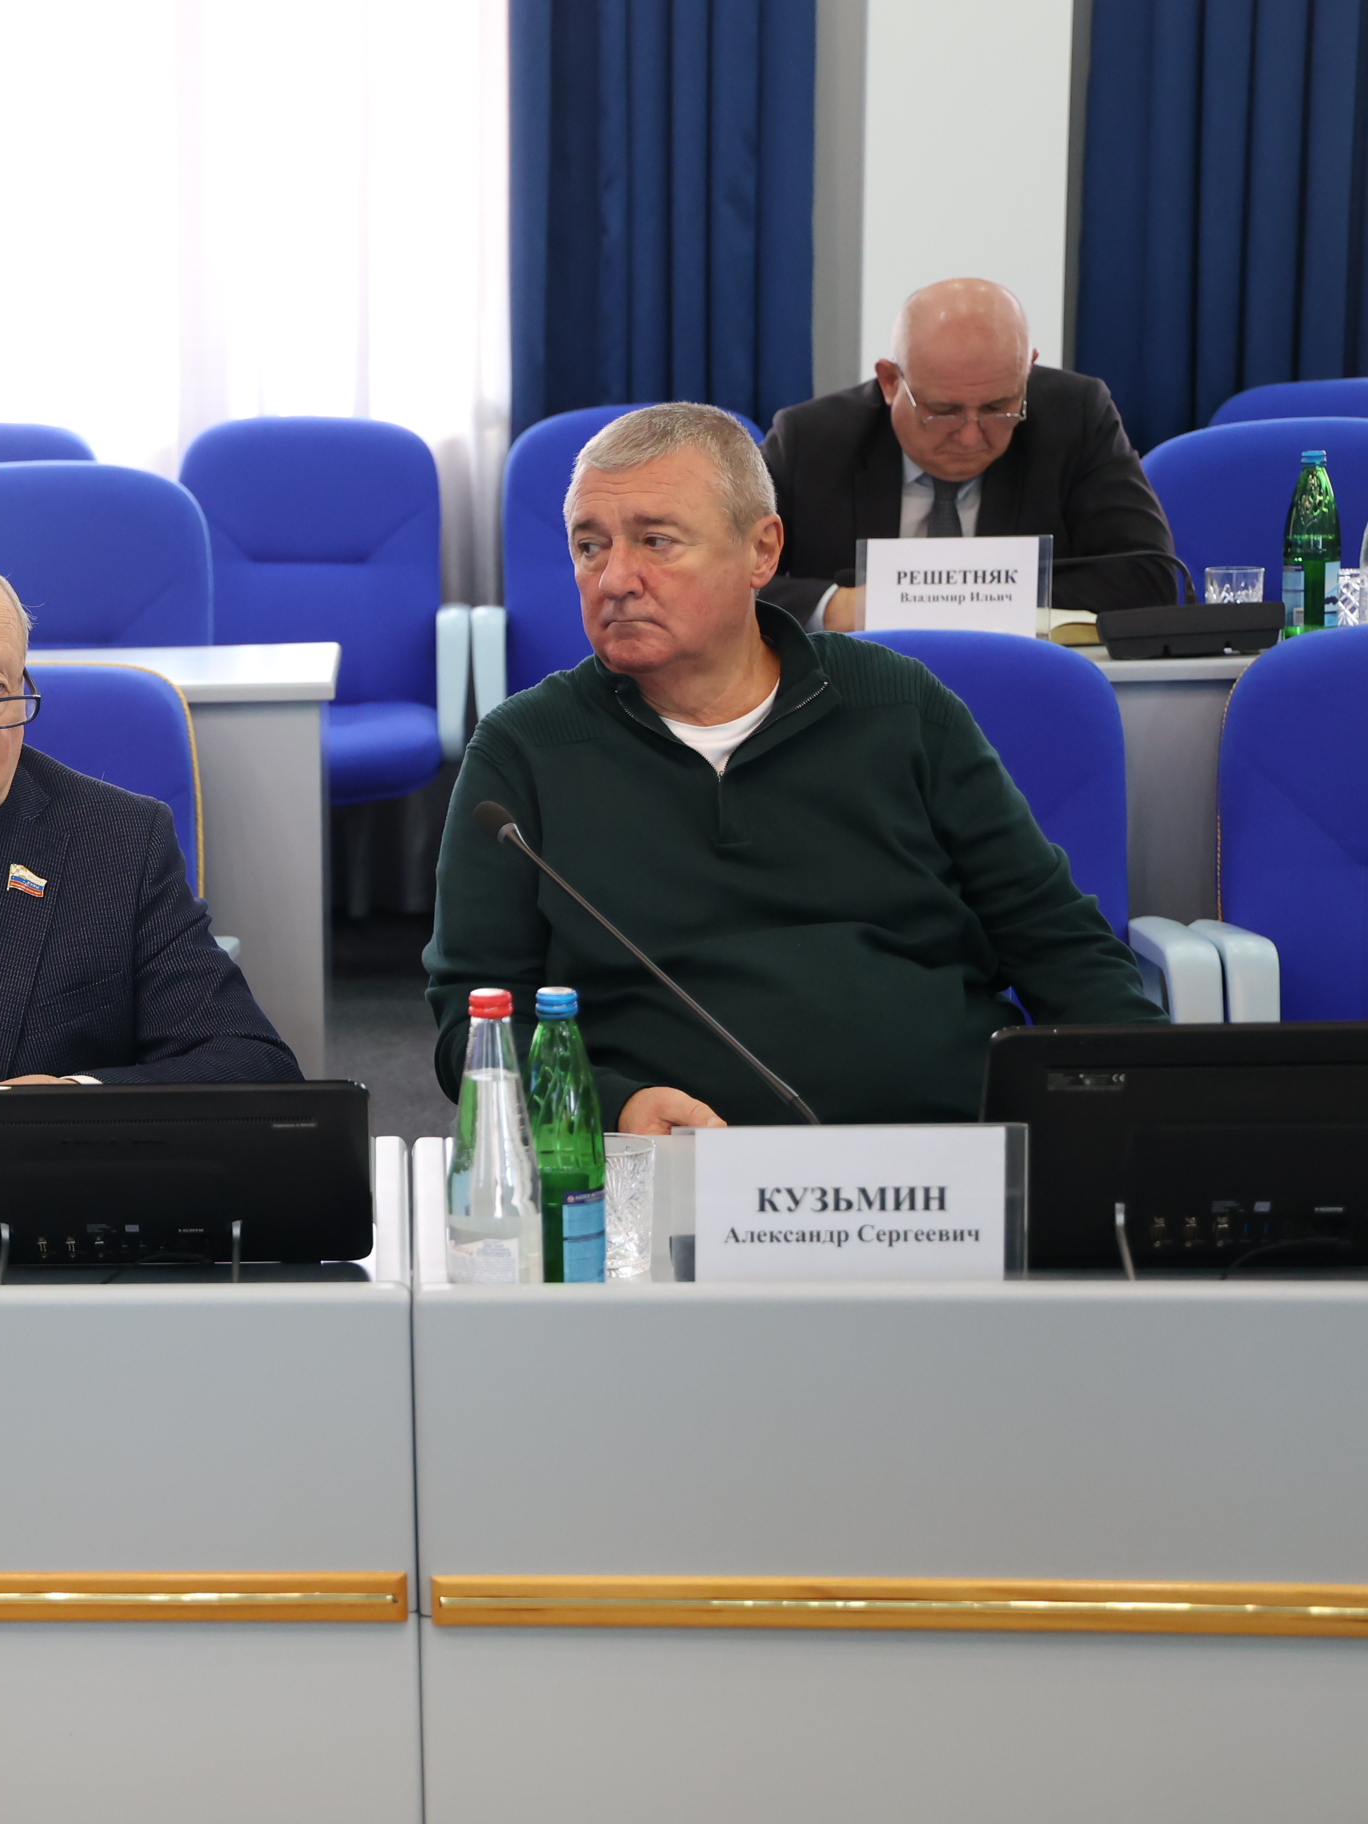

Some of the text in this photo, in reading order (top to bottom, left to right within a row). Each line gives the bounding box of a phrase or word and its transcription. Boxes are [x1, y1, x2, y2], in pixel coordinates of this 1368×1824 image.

[896, 569, 1018, 586] РЕШЕТНЯК
[900, 591, 1012, 605] Владимир Ильич
[756, 1186, 949, 1213] КУЗЬМИН
[723, 1224, 981, 1247] Александр Сергеевич
